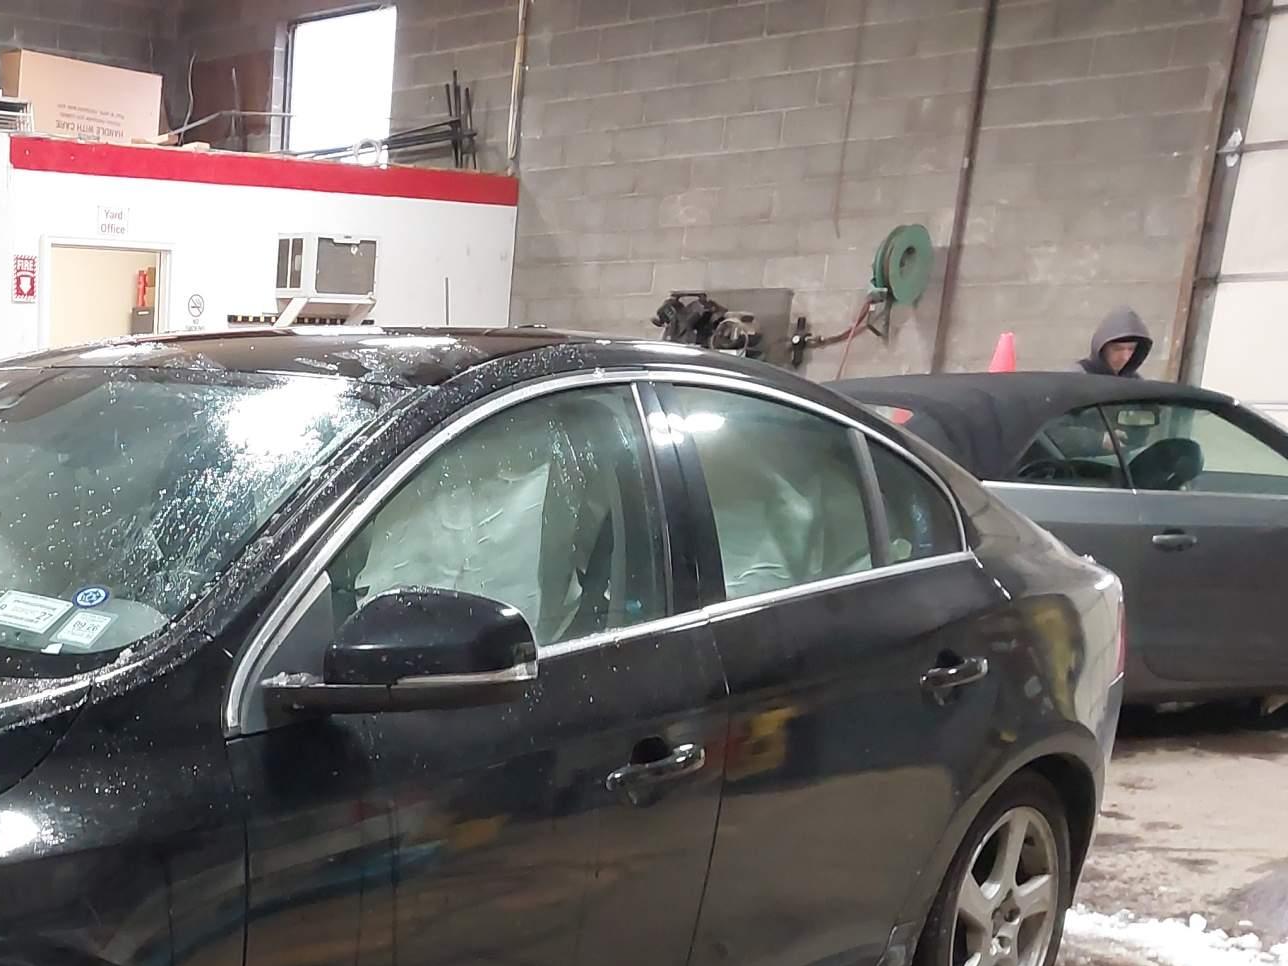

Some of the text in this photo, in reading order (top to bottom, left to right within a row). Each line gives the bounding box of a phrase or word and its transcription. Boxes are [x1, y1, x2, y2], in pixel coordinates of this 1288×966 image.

[55, 119, 75, 131] CARE
[76, 123, 94, 133] WITH
[96, 126, 124, 137] HANDLE
[104, 209, 123, 220] Yard
[101, 223, 126, 234] Office
[16, 259, 35, 271] FIRE
[35, 611, 54, 622] 27
